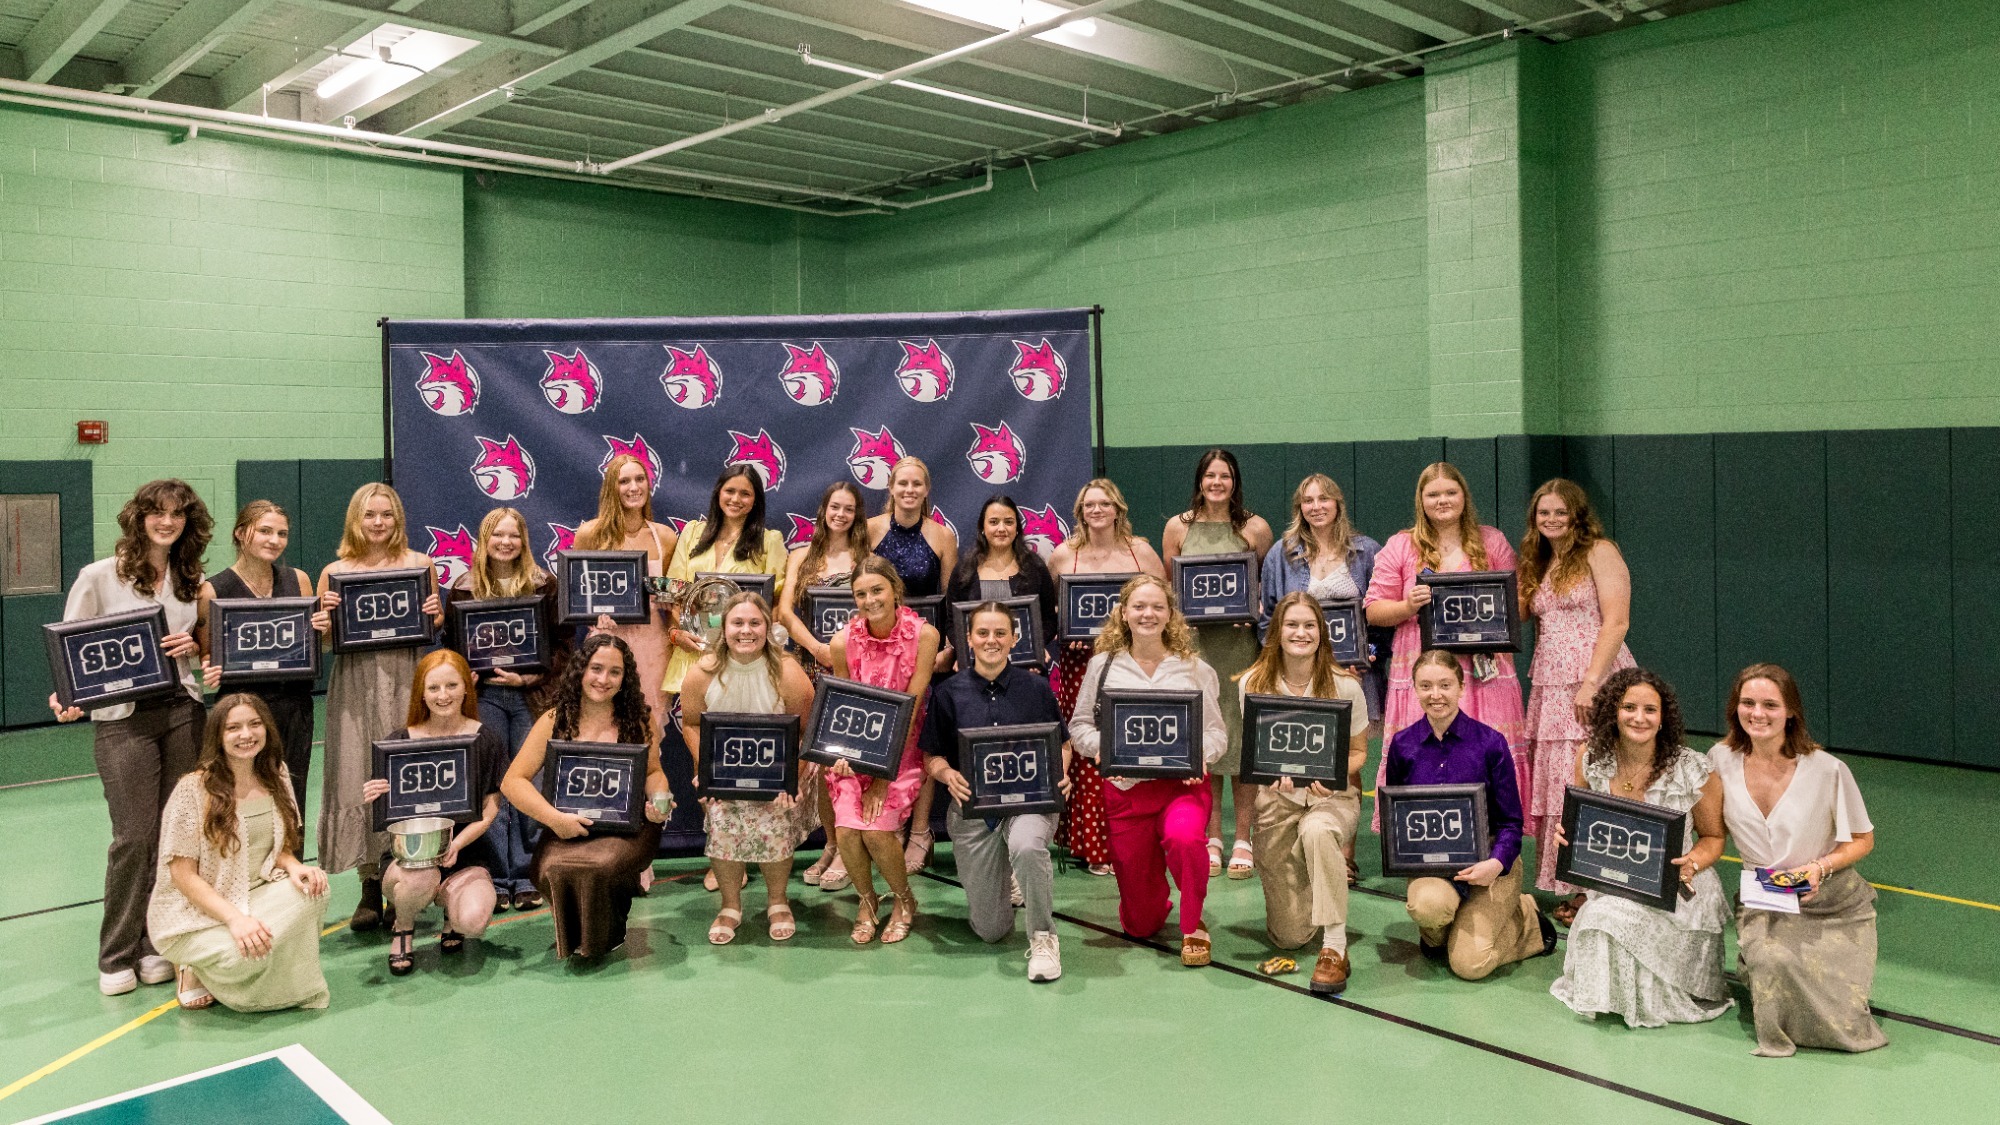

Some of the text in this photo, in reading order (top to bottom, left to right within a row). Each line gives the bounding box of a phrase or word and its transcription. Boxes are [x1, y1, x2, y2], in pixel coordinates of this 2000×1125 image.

[580, 570, 628, 596] SBC
[1192, 572, 1237, 599] SBC
[356, 590, 410, 622] SBC
[1442, 594, 1495, 623] SBC
[237, 620, 295, 650] SBC
[475, 619, 526, 649] SBC
[79, 633, 145, 675] SBC
[829, 704, 886, 741] SBC
[1124, 715, 1178, 745] SBC
[1269, 721, 1325, 754] SBC
[723, 737, 776, 767] SBC
[983, 750, 1037, 784] SBC
[400, 759, 456, 794] SBC
[566, 766, 621, 798] SBC
[1406, 809, 1463, 841] SBC
[1587, 820, 1651, 864] SBC
